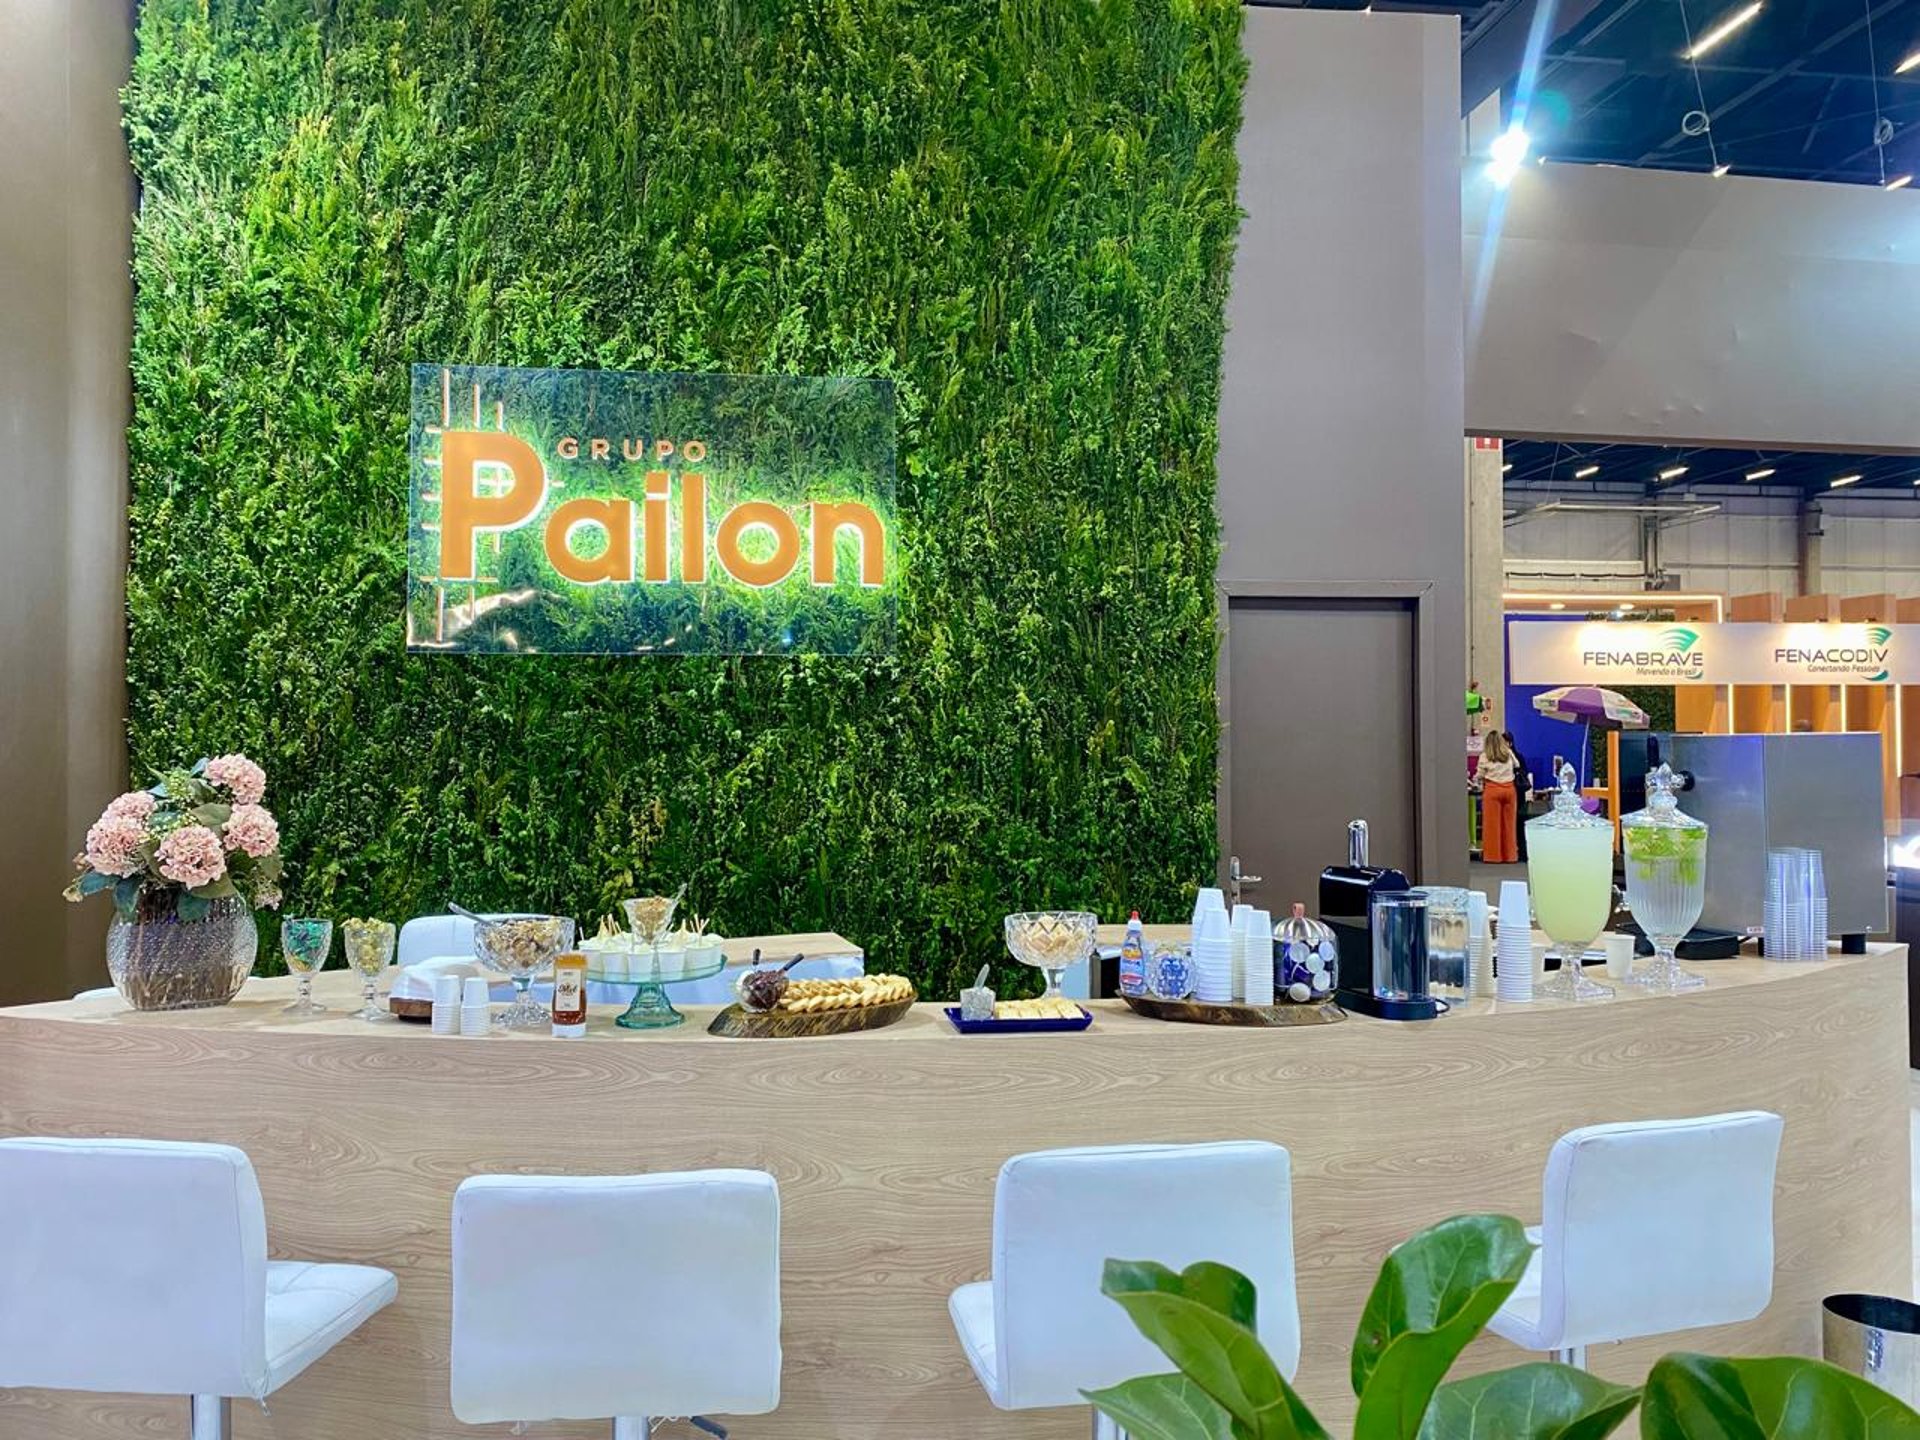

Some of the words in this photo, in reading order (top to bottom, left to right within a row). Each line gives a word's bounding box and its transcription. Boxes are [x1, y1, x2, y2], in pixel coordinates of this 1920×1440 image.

[557, 437, 707, 462] GRUPO
[440, 431, 885, 587] Pailon
[1583, 652, 1703, 666] FENABRAVE
[1775, 649, 1888, 663] FENACODIV
[1677, 667, 1697, 676] Brasil
[1808, 664, 1850, 673] Conectando
